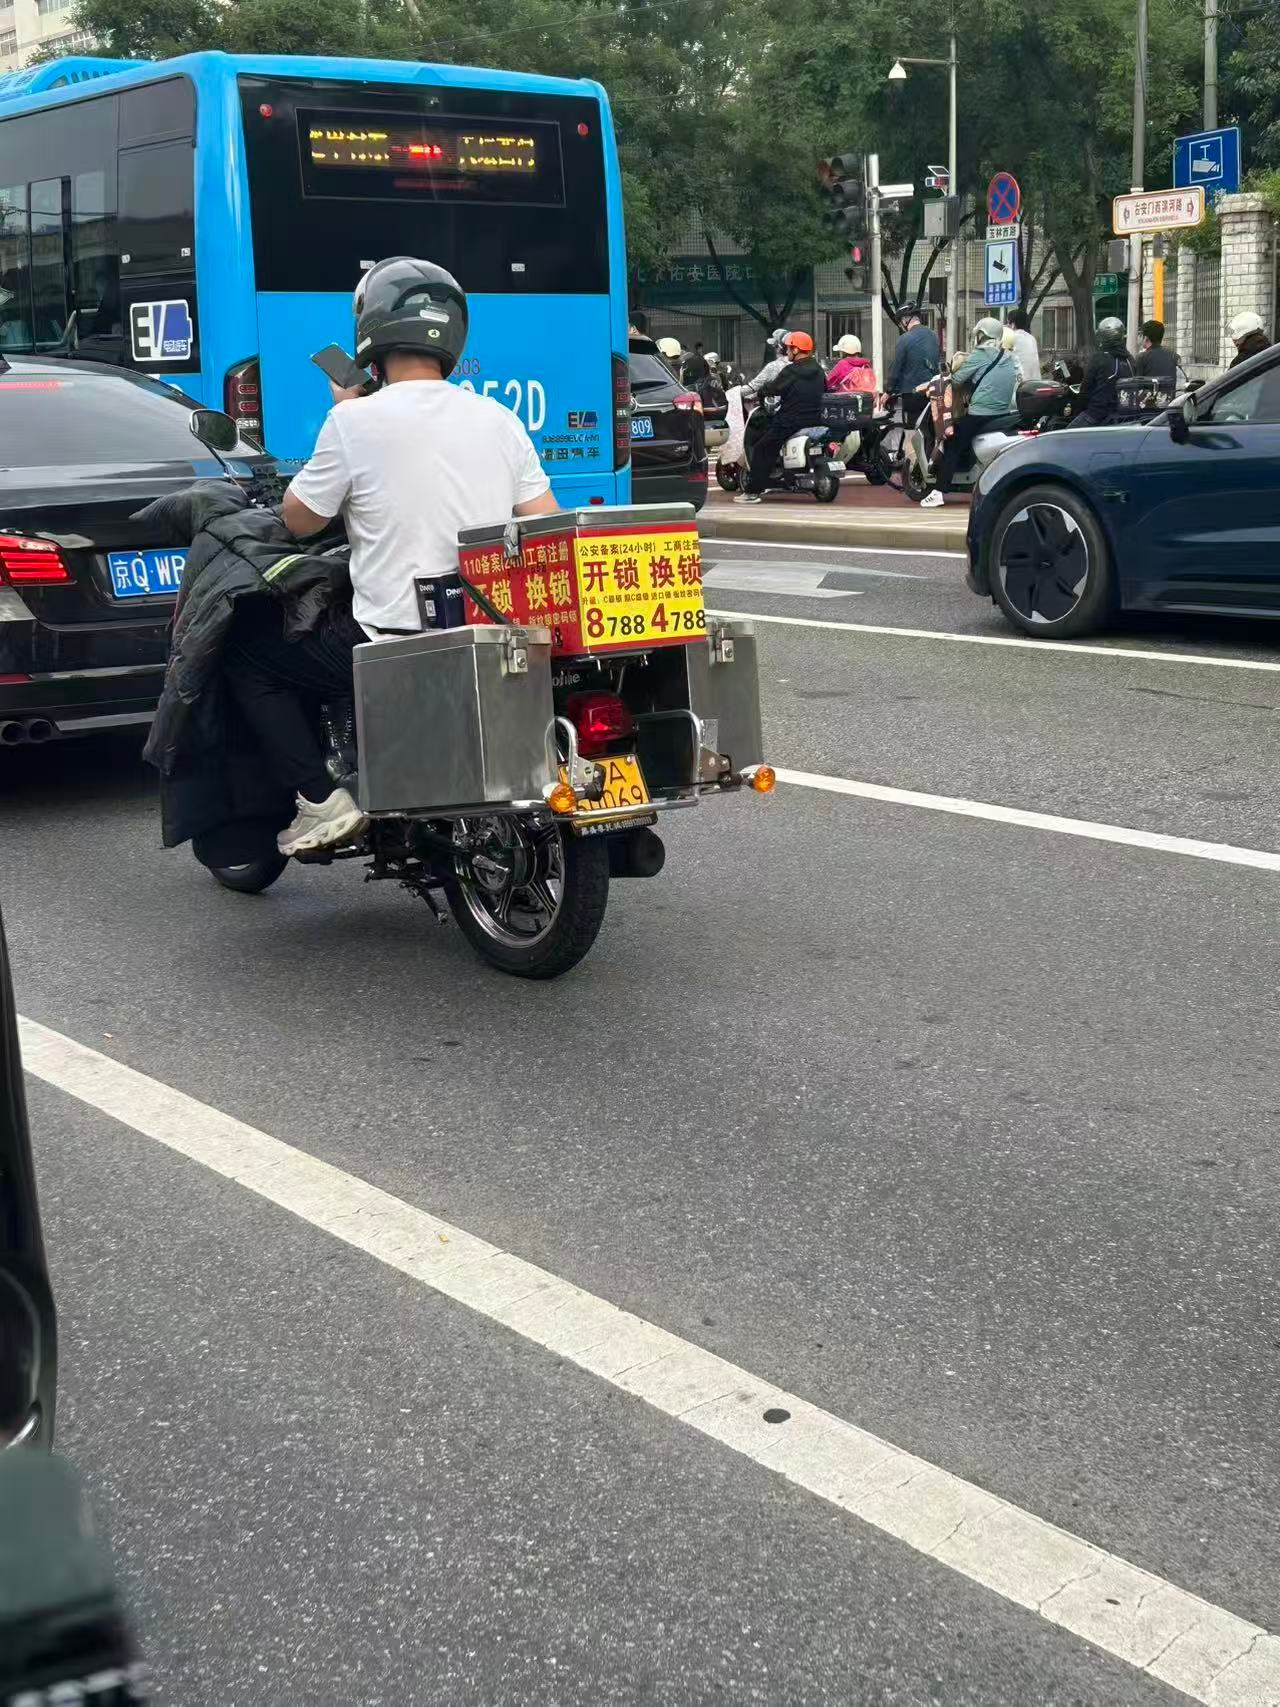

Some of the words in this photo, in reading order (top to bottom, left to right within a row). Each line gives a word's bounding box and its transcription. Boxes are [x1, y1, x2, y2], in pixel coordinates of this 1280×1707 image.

[459, 379, 546, 431] 2D
[631, 419, 652, 435] 809
[525, 569, 572, 611] 换锁
[583, 557, 641, 593] 开锁
[648, 553, 703, 589] 换锁
[586, 607, 645, 639] 8788
[650, 603, 706, 633] 4788
